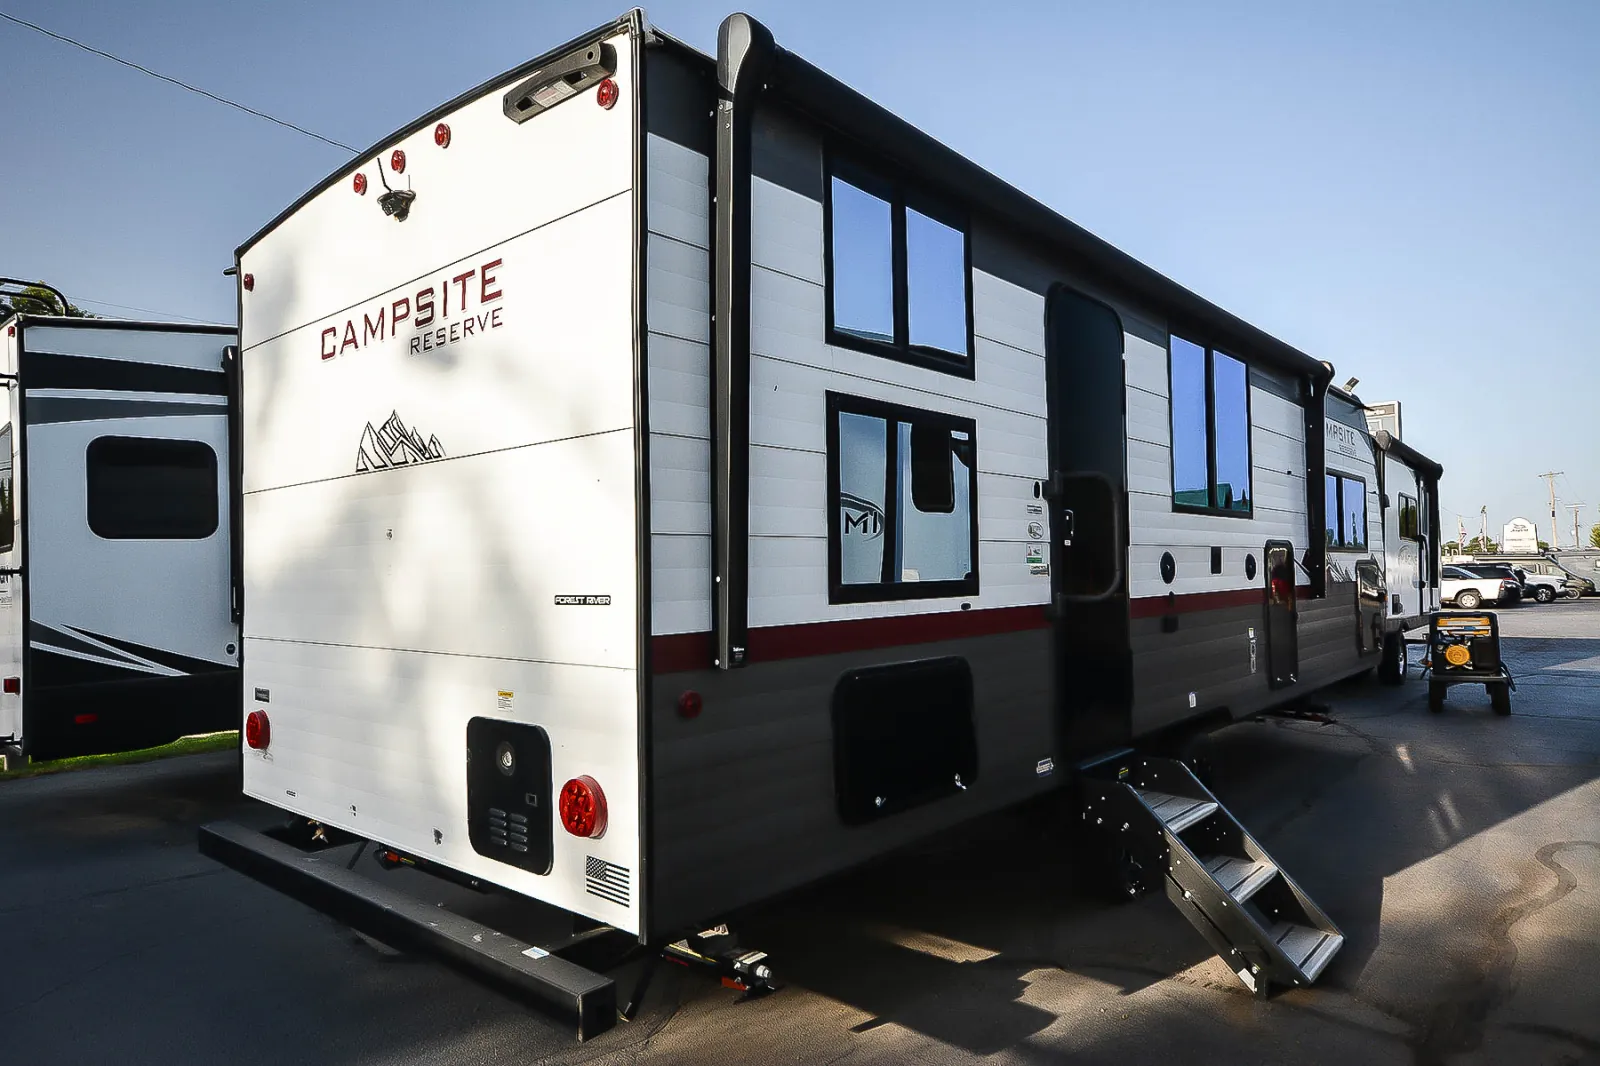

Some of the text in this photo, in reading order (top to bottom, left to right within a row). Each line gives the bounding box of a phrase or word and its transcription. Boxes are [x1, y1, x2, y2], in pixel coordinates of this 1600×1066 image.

[321, 258, 503, 361] CAMPSITE
[410, 307, 503, 355] RESERVE
[1325, 421, 1356, 446] MPSITE
[555, 596, 610, 605] FOREST RIVER
